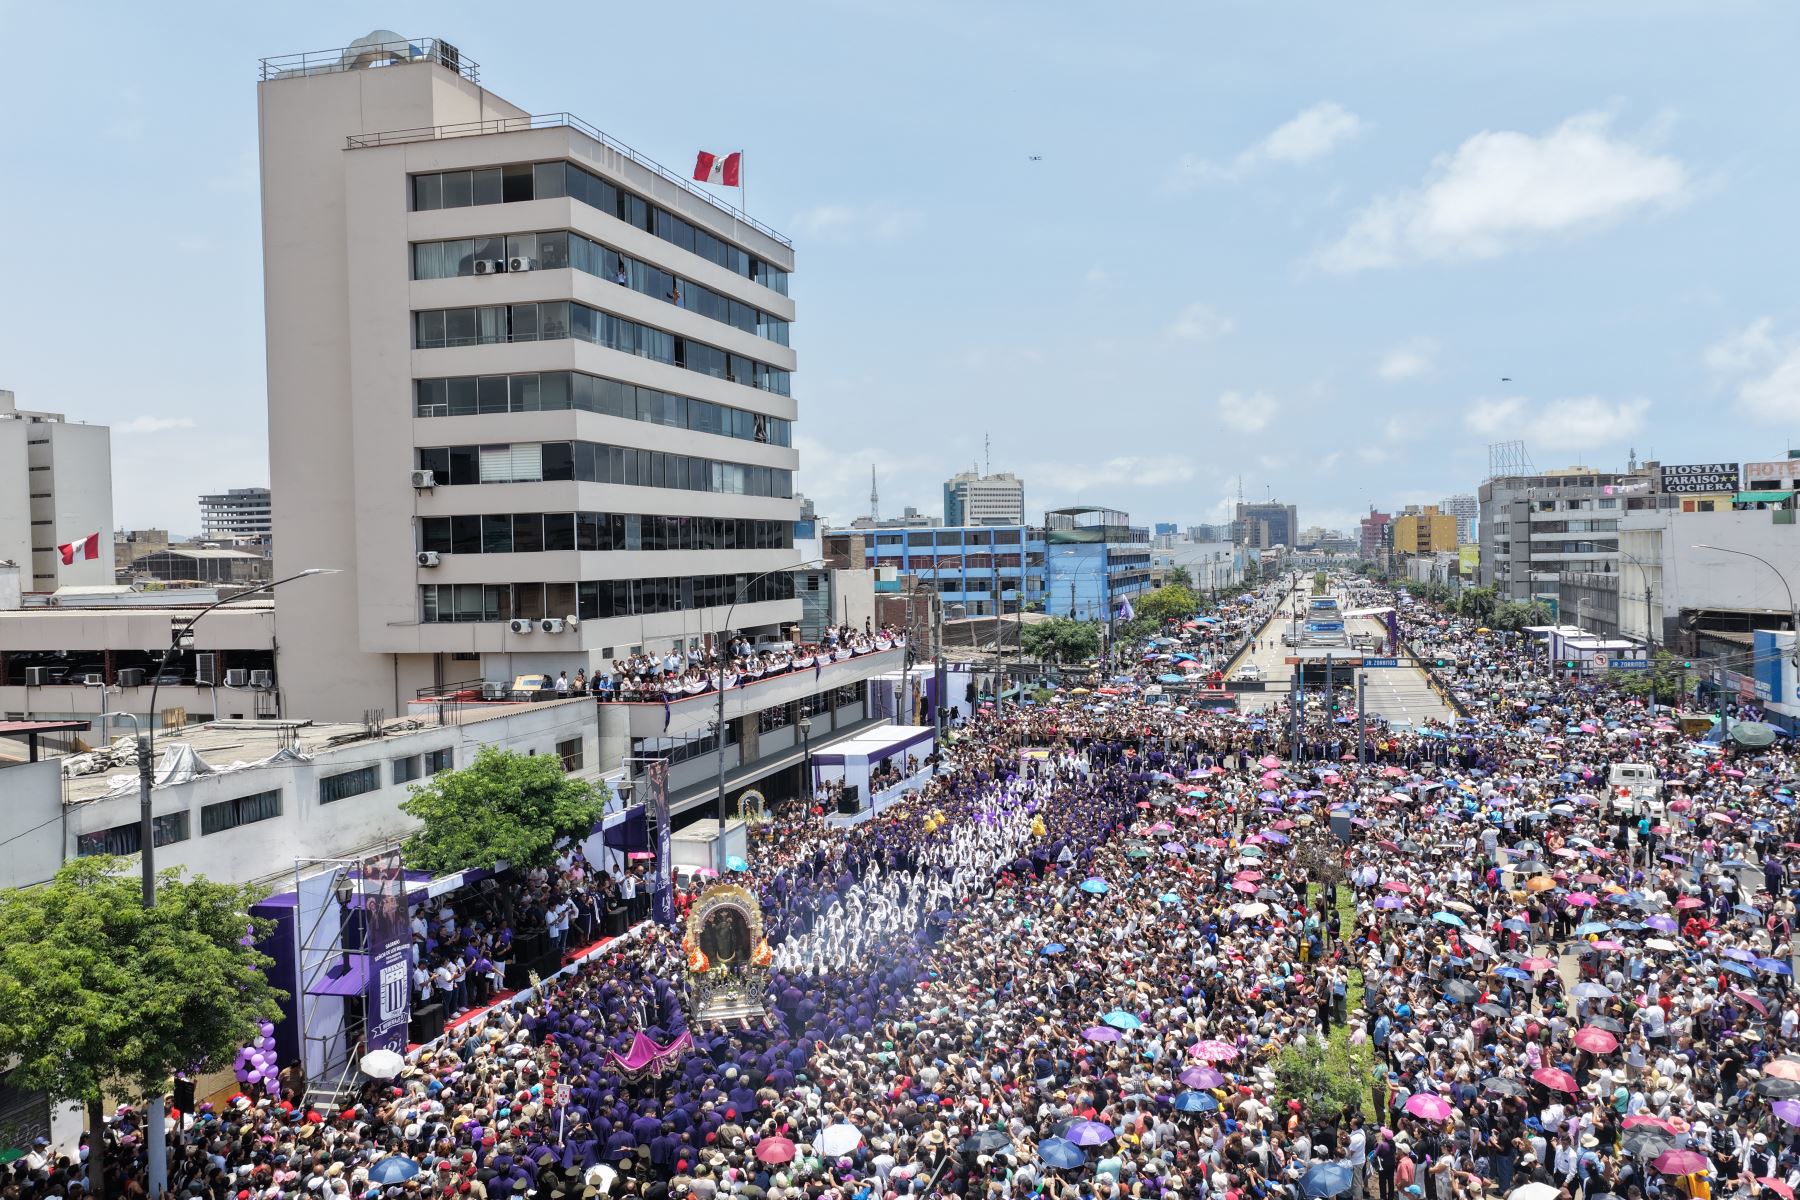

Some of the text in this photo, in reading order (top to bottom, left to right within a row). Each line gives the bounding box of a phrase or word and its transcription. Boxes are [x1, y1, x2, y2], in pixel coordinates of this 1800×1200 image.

[1665, 463, 1735, 475] HOSTAL
[1665, 475, 1719, 485] PARAISO
[1667, 483, 1734, 492] COCHERA
